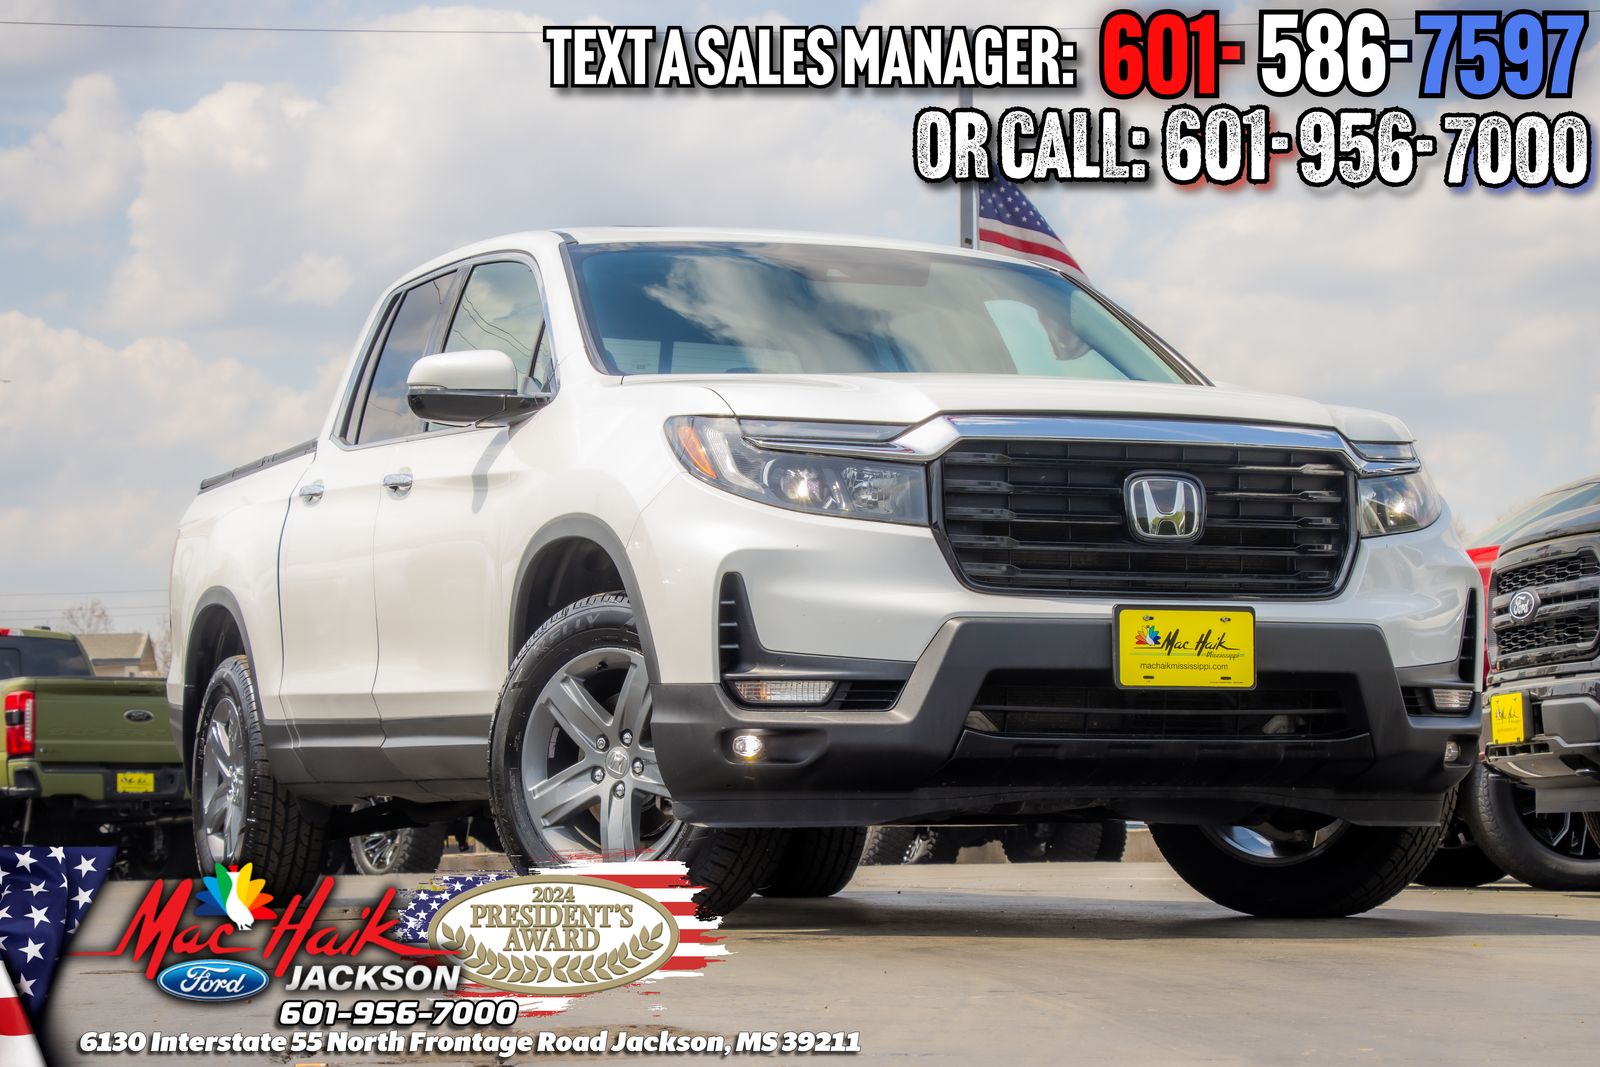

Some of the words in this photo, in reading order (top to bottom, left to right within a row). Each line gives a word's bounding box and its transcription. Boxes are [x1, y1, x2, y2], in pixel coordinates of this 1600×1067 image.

[1160, 628, 1190, 656] Mac
[1194, 629, 1232, 656] Haik
[1140, 662, 1229, 671] machaikmississippi.com
